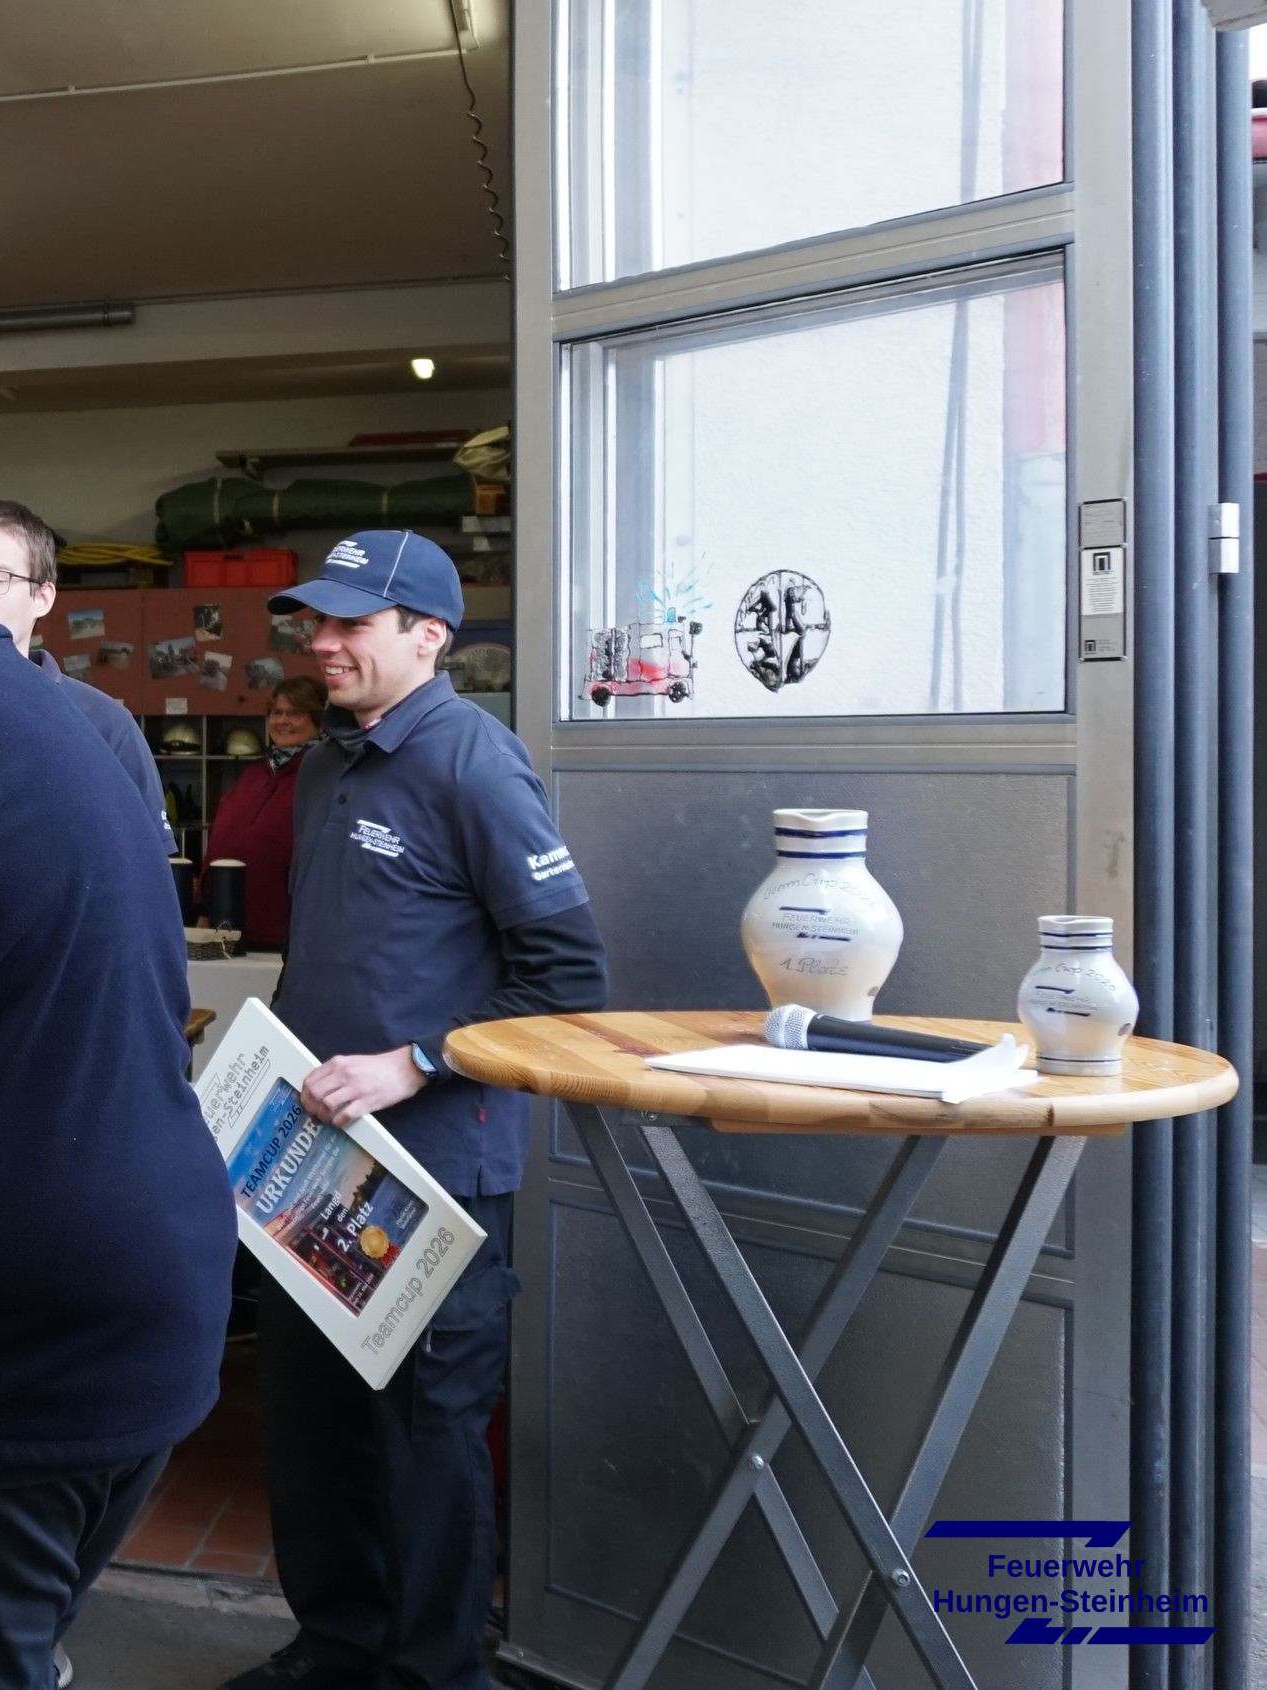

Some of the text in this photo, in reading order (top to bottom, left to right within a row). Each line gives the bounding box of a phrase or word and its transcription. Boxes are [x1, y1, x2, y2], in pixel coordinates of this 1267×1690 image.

[358, 825, 400, 844] FEUERWEHR
[781, 913, 851, 925] FEUERWEHR
[795, 957, 850, 976] Platz
[204, 1053, 245, 1122] uerwehr
[212, 1045, 270, 1136] en-Steinheim
[240, 1137, 281, 1199] TEAMCUP
[278, 1103, 302, 1139] 2026
[255, 1117, 323, 1214] URKUNDE
[320, 1190, 342, 1220] Langd
[337, 1207, 349, 1222] den
[337, 1201, 374, 1252] 2. Platz
[361, 1277, 424, 1355] Teamcup
[416, 1226, 455, 1278] 2026
